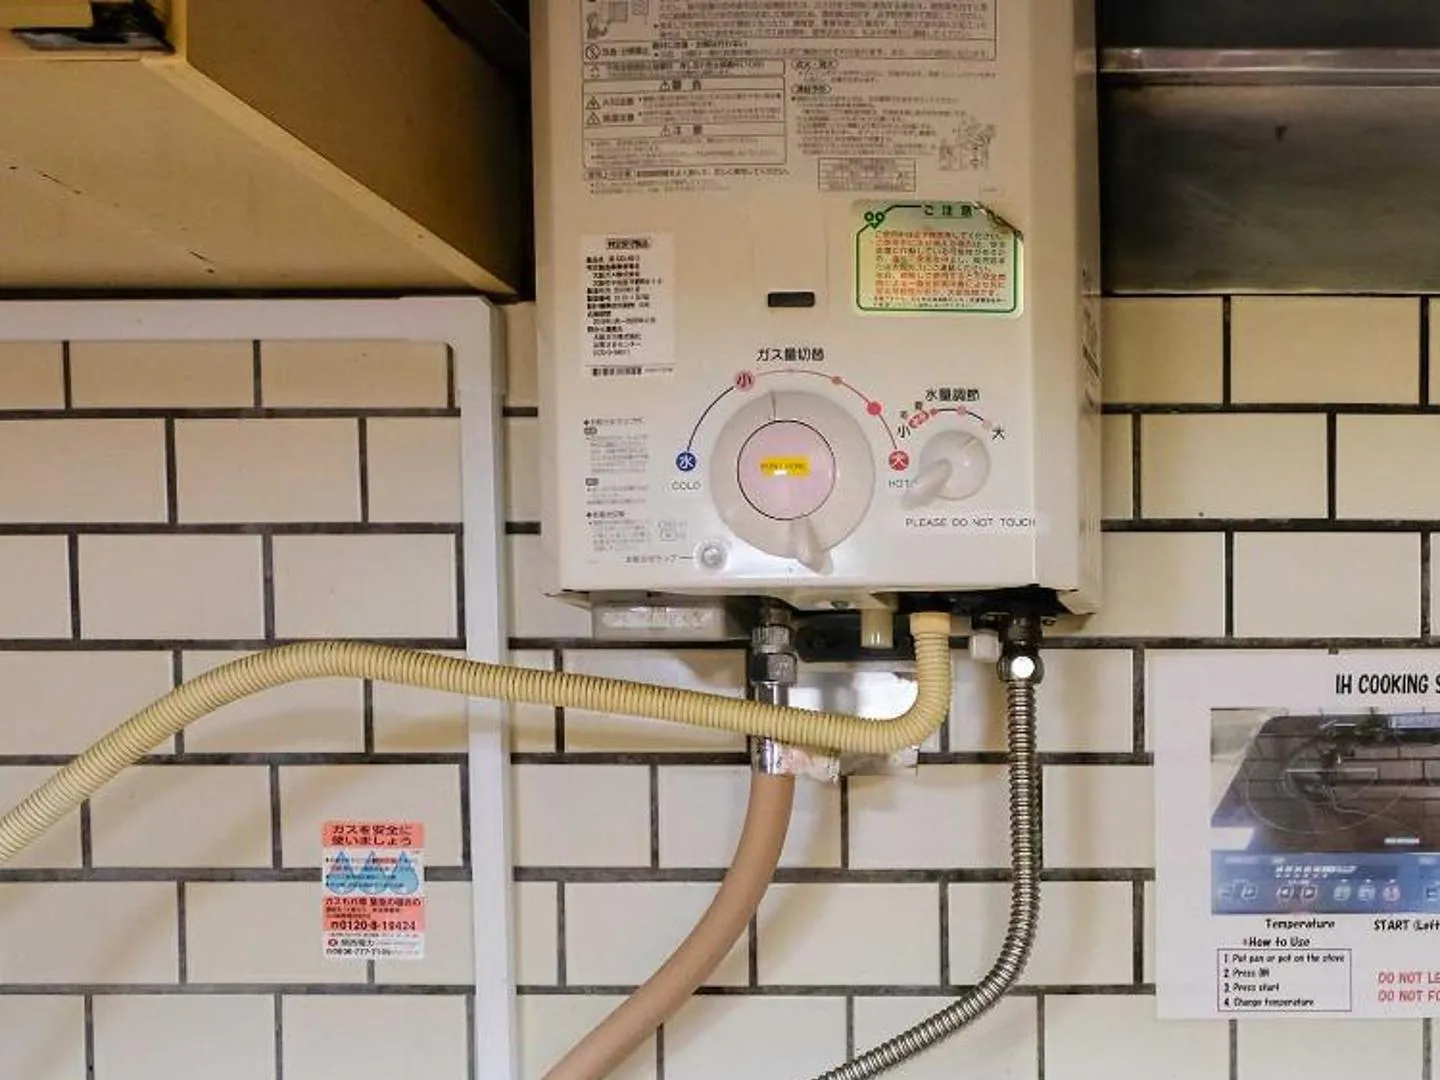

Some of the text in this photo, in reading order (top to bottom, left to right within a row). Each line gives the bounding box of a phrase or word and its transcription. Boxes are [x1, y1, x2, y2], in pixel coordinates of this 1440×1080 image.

[736, 373, 752, 388] 小
[991, 427, 1006, 441] 大
[678, 454, 695, 470] 水
[905, 518, 1036, 527] PLEASE DO NOT TOUCH
[1335, 673, 1352, 694] IH
[1358, 673, 1429, 694] COOKING
[1265, 918, 1335, 929] Temperature
[1374, 919, 1408, 931] START
[1250, 936, 1311, 947] How to Use
[1232, 954, 1247, 963] Put
[1266, 955, 1276, 963] or
[1294, 955, 1305, 963] on
[1307, 954, 1320, 963] the
[1322, 954, 1345, 963] stove
[1232, 968, 1256, 977] Press
[1378, 972, 1395, 984] DO
[1400, 972, 1423, 984] NOT
[1232, 982, 1256, 992] Press
[1234, 997, 1262, 1007] Change
[1265, 996, 1315, 1007] temperature
[1378, 990, 1395, 1002] DO
[1400, 990, 1423, 1002] NOT
